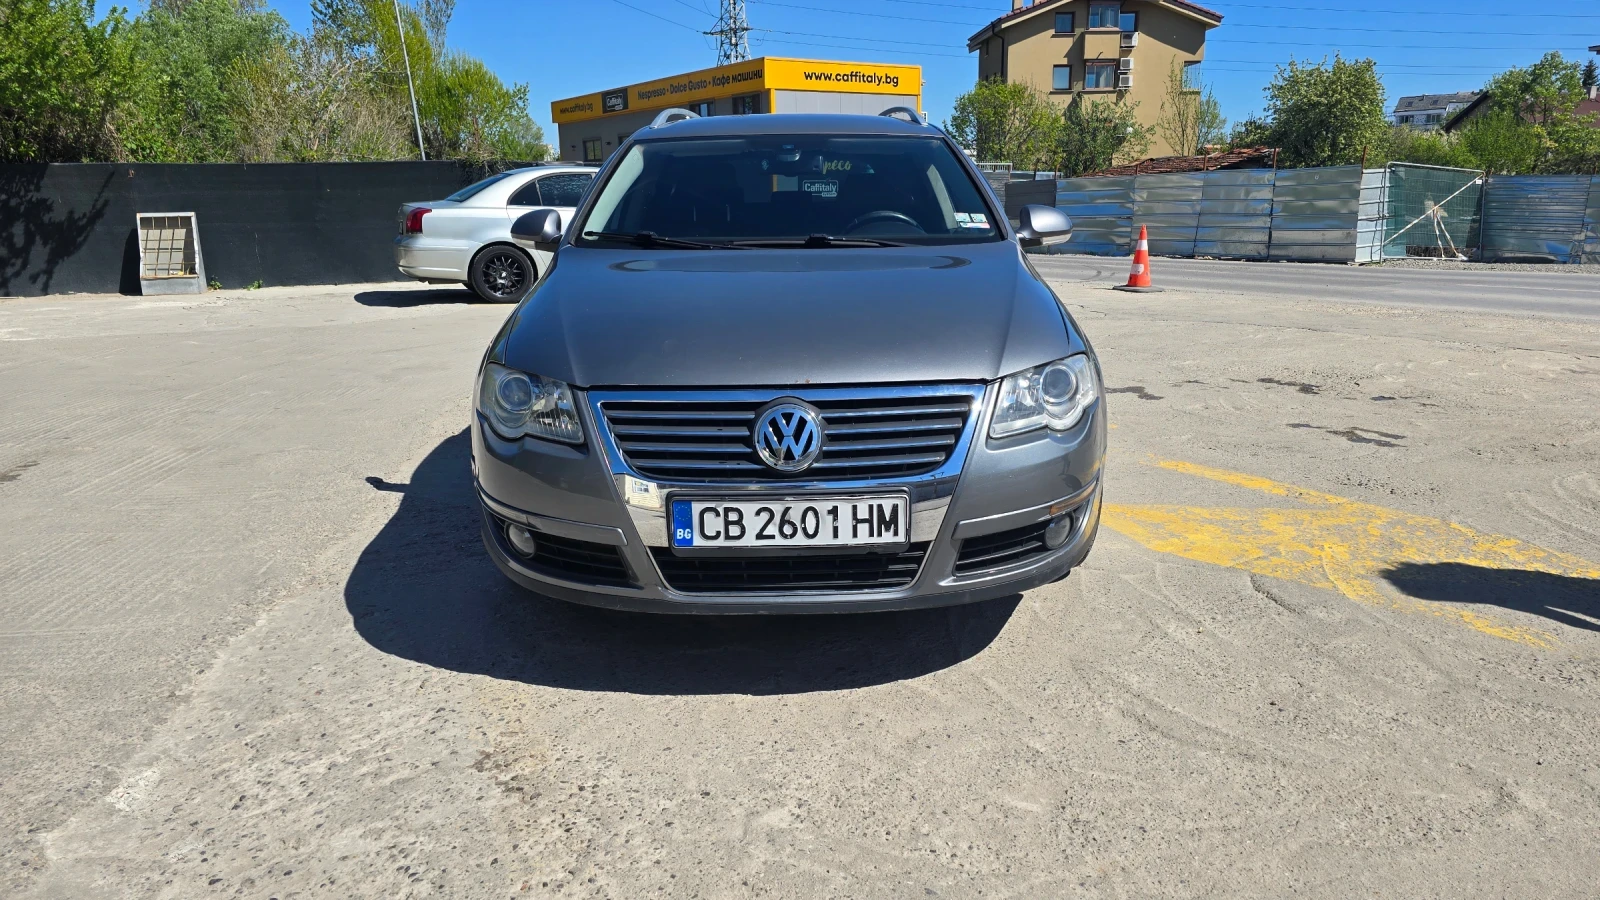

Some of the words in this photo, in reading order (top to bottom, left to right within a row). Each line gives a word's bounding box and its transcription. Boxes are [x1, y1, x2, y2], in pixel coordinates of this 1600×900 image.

[637, 87, 666, 101] Nespresso
[669, 82, 688, 94] Dolce
[688, 79, 708, 91] Gusto
[712, 74, 731, 88] Кафе
[731, 69, 763, 83] машини
[803, 71, 899, 87] www.caffitaly.bg
[804, 183, 837, 193] Caffitaly
[754, 505, 839, 540] 2601
[676, 529, 692, 540] BG
